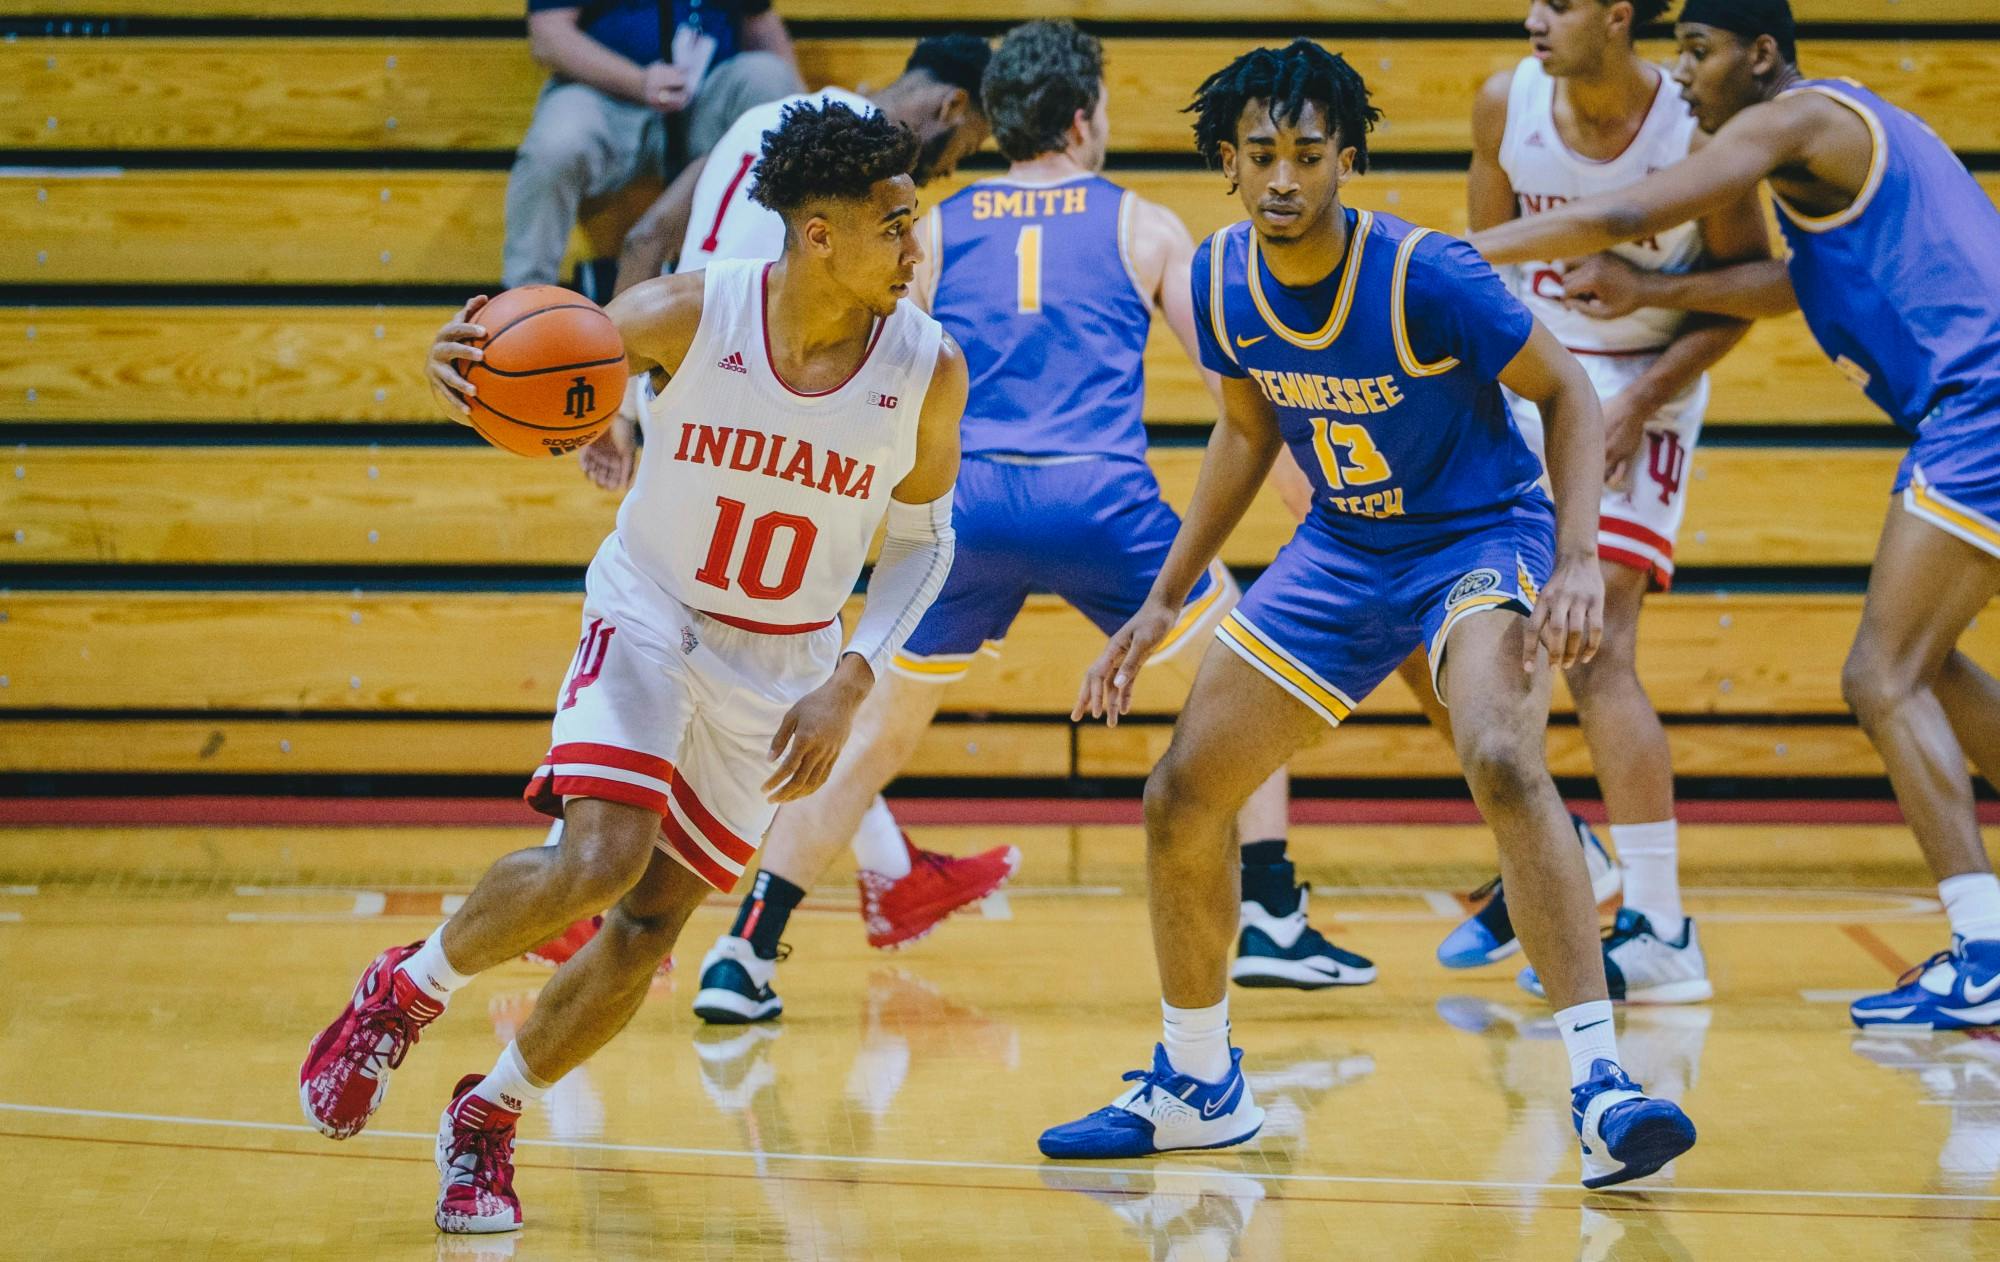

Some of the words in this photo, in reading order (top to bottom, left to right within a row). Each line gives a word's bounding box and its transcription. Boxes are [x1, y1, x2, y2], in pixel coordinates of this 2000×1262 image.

[972, 187, 1087, 220] SMITH
[1015, 224, 1043, 314] 1
[717, 361, 747, 374] adidas
[1247, 367, 1405, 414] TENNESSEE
[674, 423, 876, 499] INDIANA
[1308, 417, 1392, 490] 13
[695, 495, 818, 600] 10
